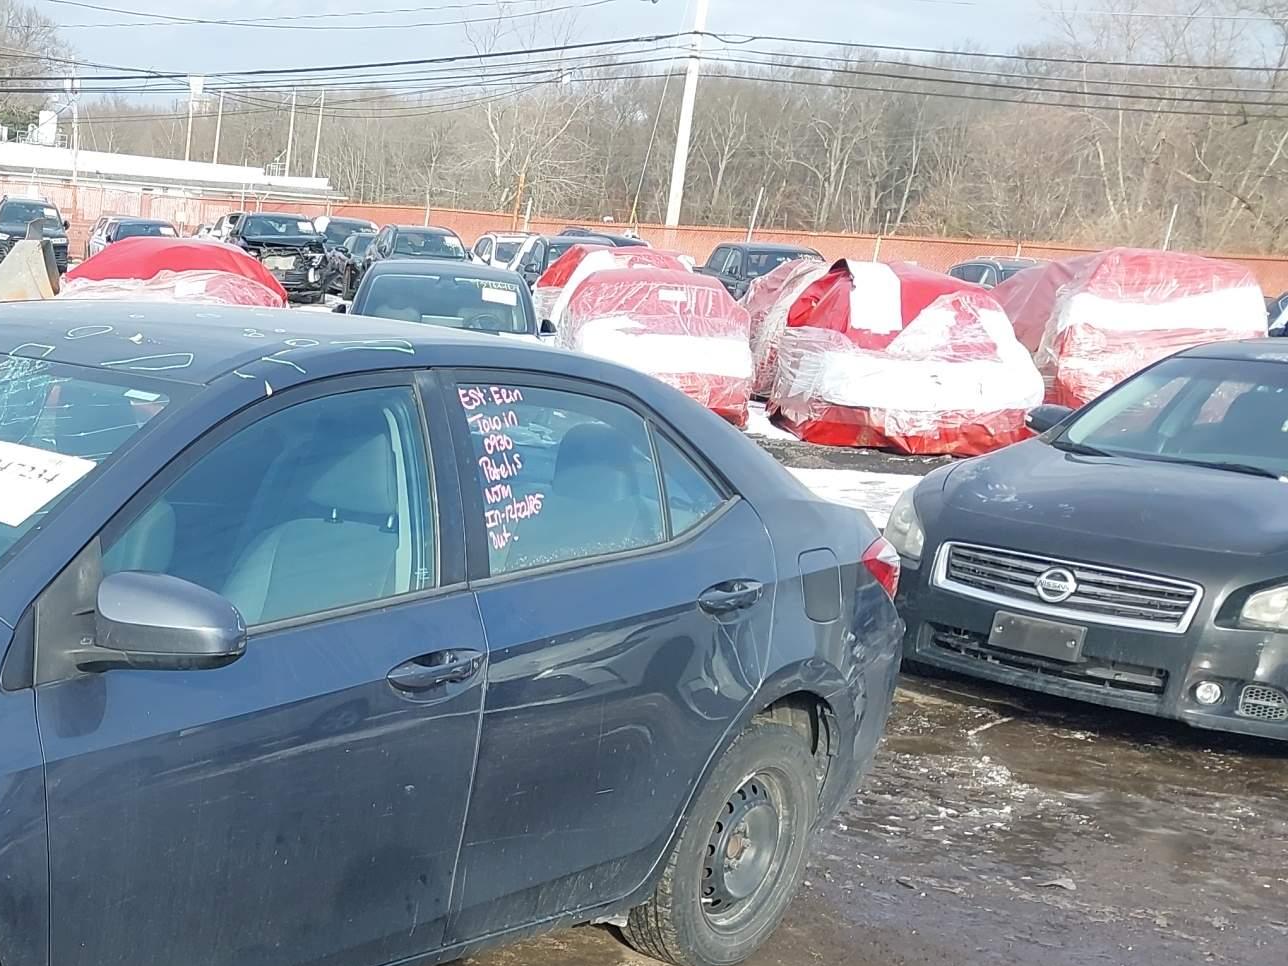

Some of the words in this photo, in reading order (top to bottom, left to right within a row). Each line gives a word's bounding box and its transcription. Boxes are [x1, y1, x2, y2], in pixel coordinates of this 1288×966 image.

[502, 410, 518, 428] in
[484, 484, 513, 504] NJM
[1038, 579, 1070, 592] NISSAN
